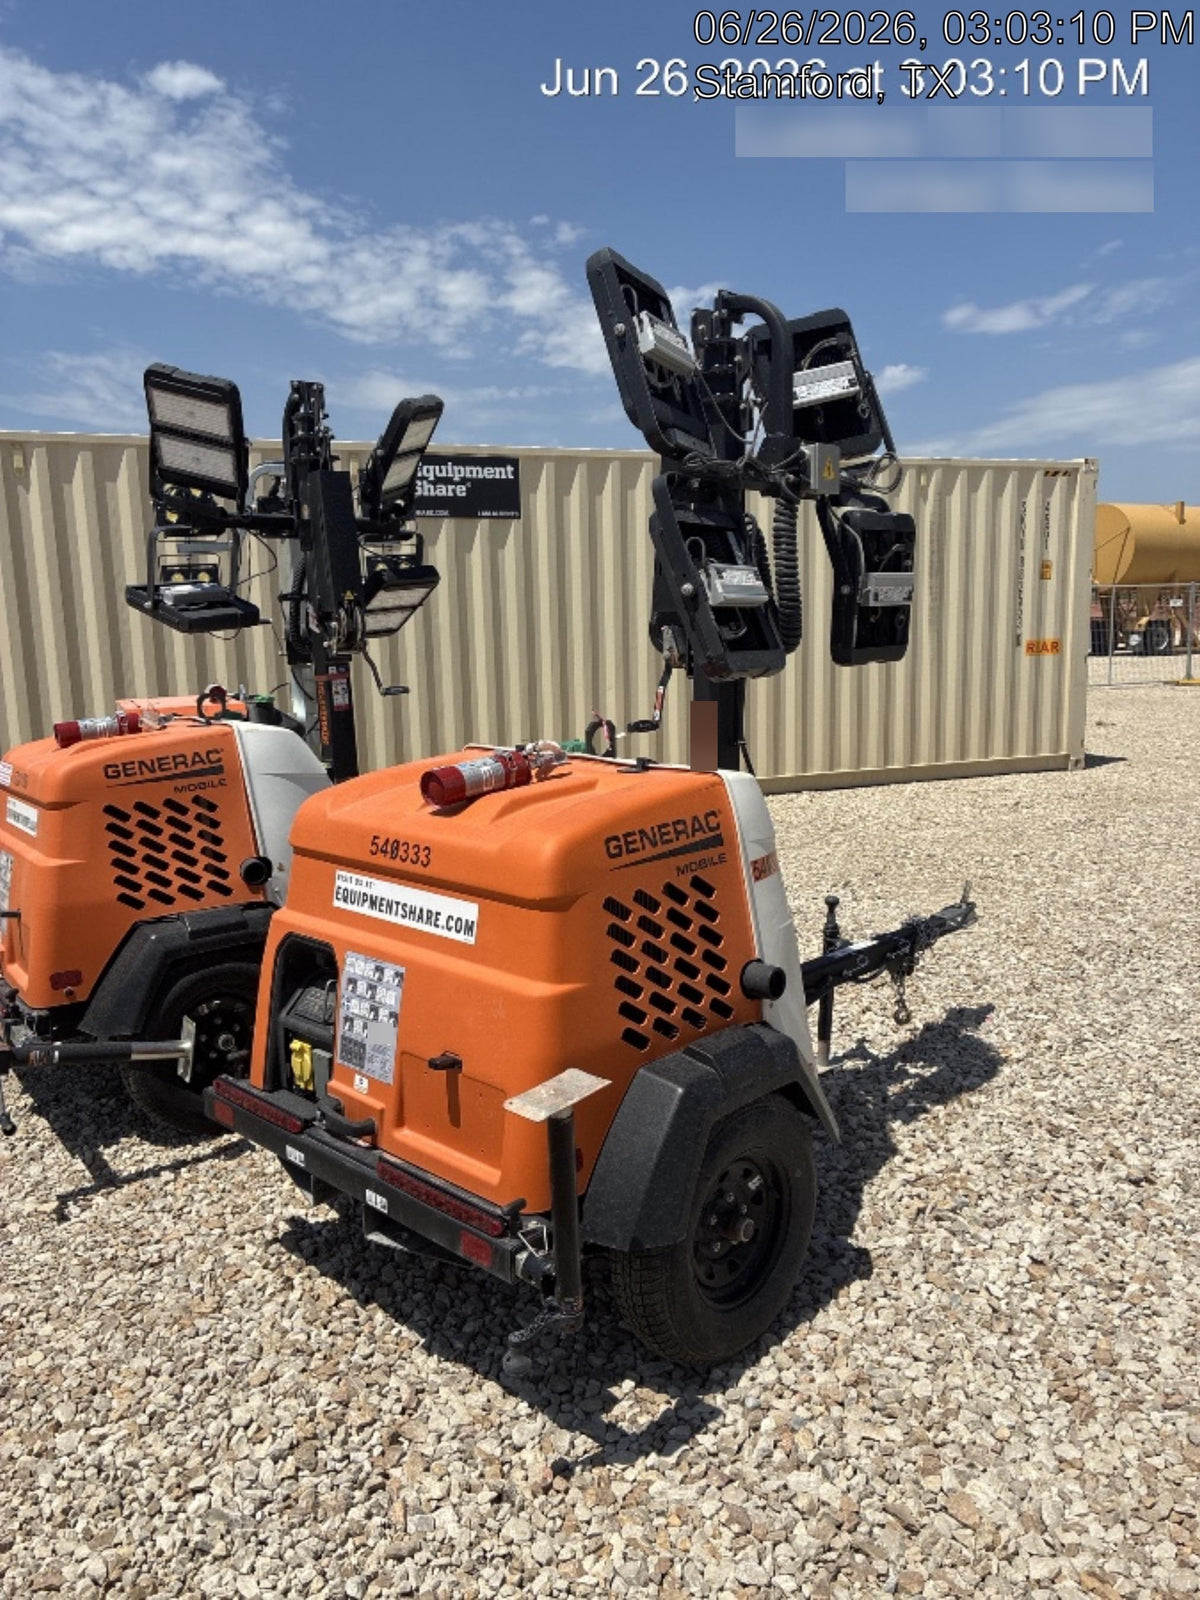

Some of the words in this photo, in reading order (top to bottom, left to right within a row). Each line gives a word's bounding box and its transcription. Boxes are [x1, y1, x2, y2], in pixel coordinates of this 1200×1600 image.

[103, 748, 223, 779] GENERAC
[604, 810, 721, 859] GENERAC
[369, 835, 431, 868] 540333
[675, 853, 727, 877] MOBILE
[335, 886, 475, 937] EQUIPMENTSHARE.COM
